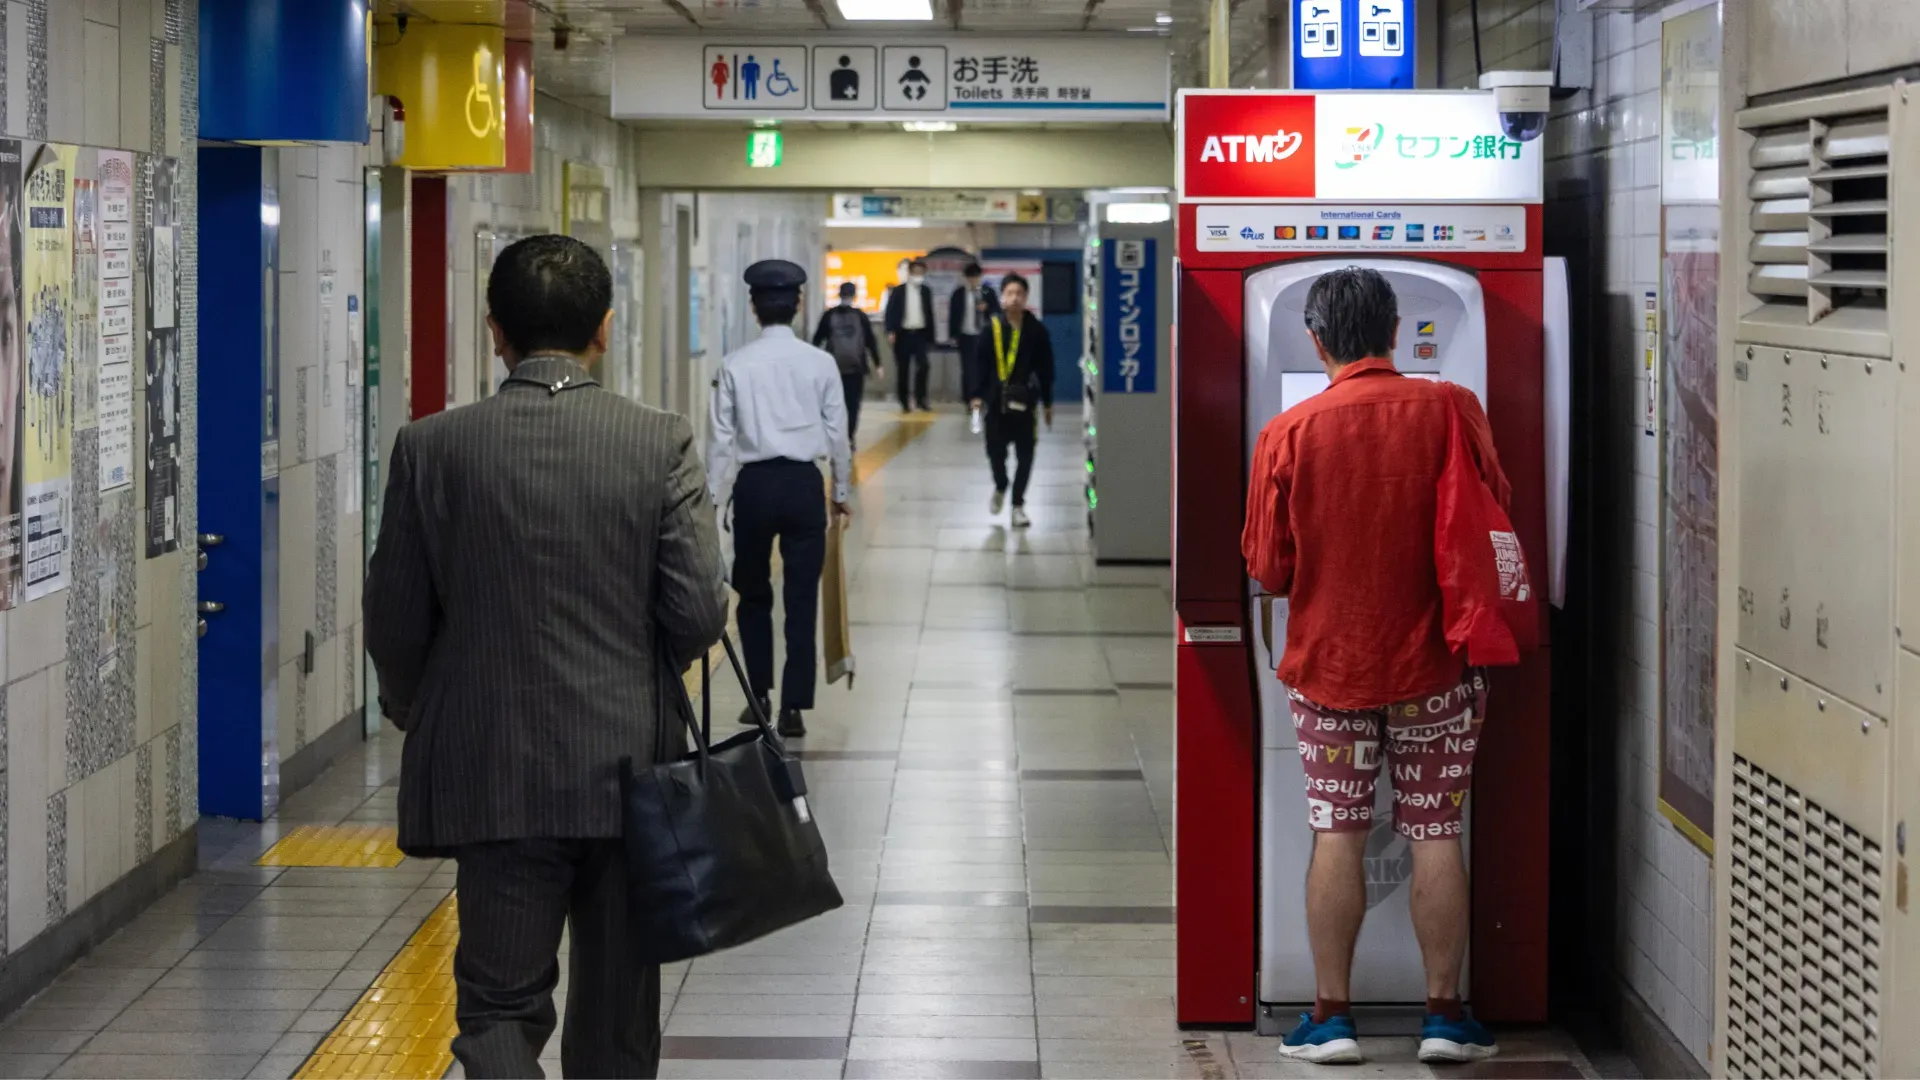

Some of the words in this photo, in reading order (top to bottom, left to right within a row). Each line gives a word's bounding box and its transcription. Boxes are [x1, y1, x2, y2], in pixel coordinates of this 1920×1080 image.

[953, 56, 1039, 84] お手洗
[954, 87, 1003, 100] Toilets
[1396, 134, 1522, 160] セブン銀行
[1321, 211, 1374, 219] International
[1377, 211, 1401, 219] Cards
[1426, 692, 1452, 713] Of
[1314, 717, 1378, 737] Never
